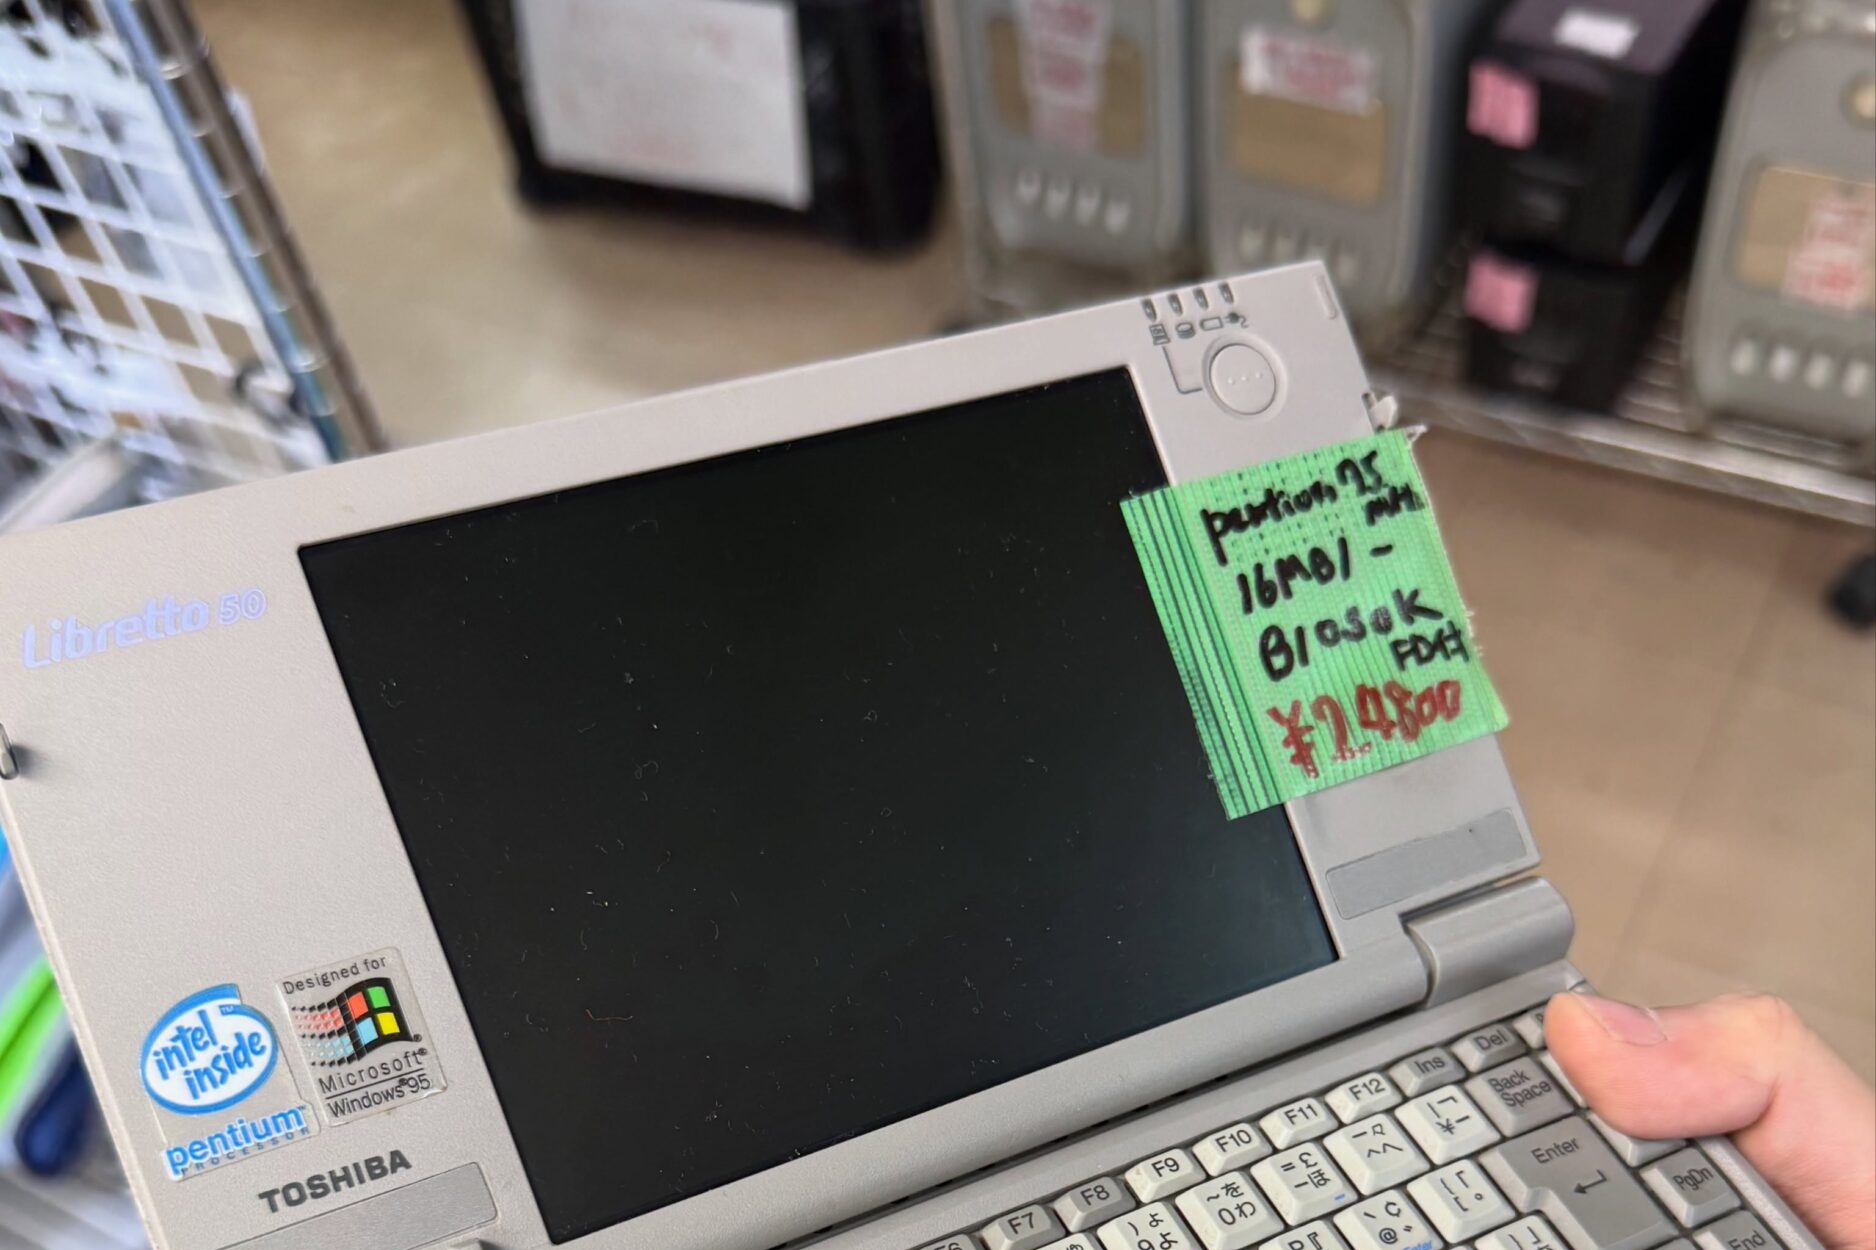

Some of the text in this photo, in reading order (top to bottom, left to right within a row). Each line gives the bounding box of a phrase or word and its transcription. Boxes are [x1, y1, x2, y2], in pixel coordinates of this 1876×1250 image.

[21, 586, 267, 668] Libretto 50
[283, 956, 387, 994] Designed for
[153, 1009, 218, 1080] intel
[1475, 1032, 1507, 1053] Del
[183, 1031, 267, 1100] inside
[1417, 1055, 1446, 1075] Ins
[1350, 1079, 1385, 1100] F12
[1489, 1071, 1529, 1092] Back
[1501, 1080, 1551, 1108] Space
[1285, 1104, 1318, 1125] F11
[166, 1106, 304, 1176] pentium
[180, 1127, 310, 1176] PROCESSOR
[1215, 1129, 1252, 1153] F10
[1532, 1138, 1579, 1164] Enter
[1152, 1158, 1180, 1177] F9
[1674, 1167, 1714, 1191] PgDn
[259, 1149, 412, 1213] TOSHIBA
[1081, 1185, 1110, 1206] F8
[1235, 1202, 1256, 1218] わ
[1008, 1212, 1036, 1234] F7
[1160, 1232, 1178, 1250] よ
